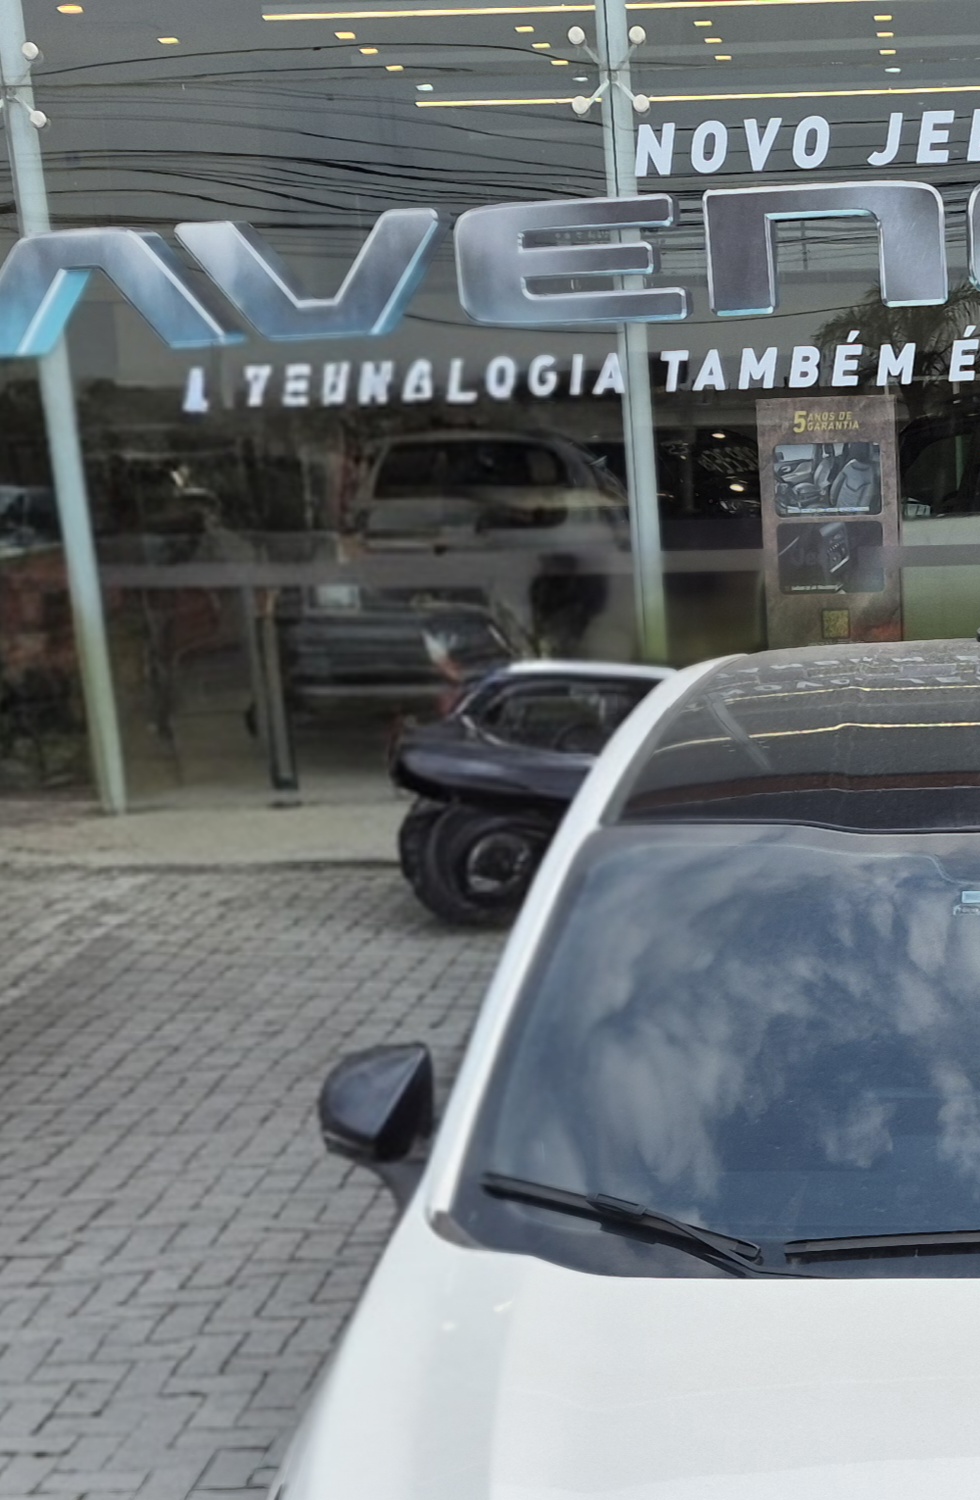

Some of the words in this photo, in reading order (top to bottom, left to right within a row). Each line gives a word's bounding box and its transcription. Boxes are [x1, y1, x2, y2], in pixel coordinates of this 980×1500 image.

[635, 115, 831, 177] NOVO
[660, 330, 916, 393] TAMBÉM
[948, 325, 977, 382] É
[793, 410, 807, 433] 5
[807, 412, 835, 421] ANOS
[838, 411, 853, 421] DE
[807, 421, 860, 431] GARANTIA
